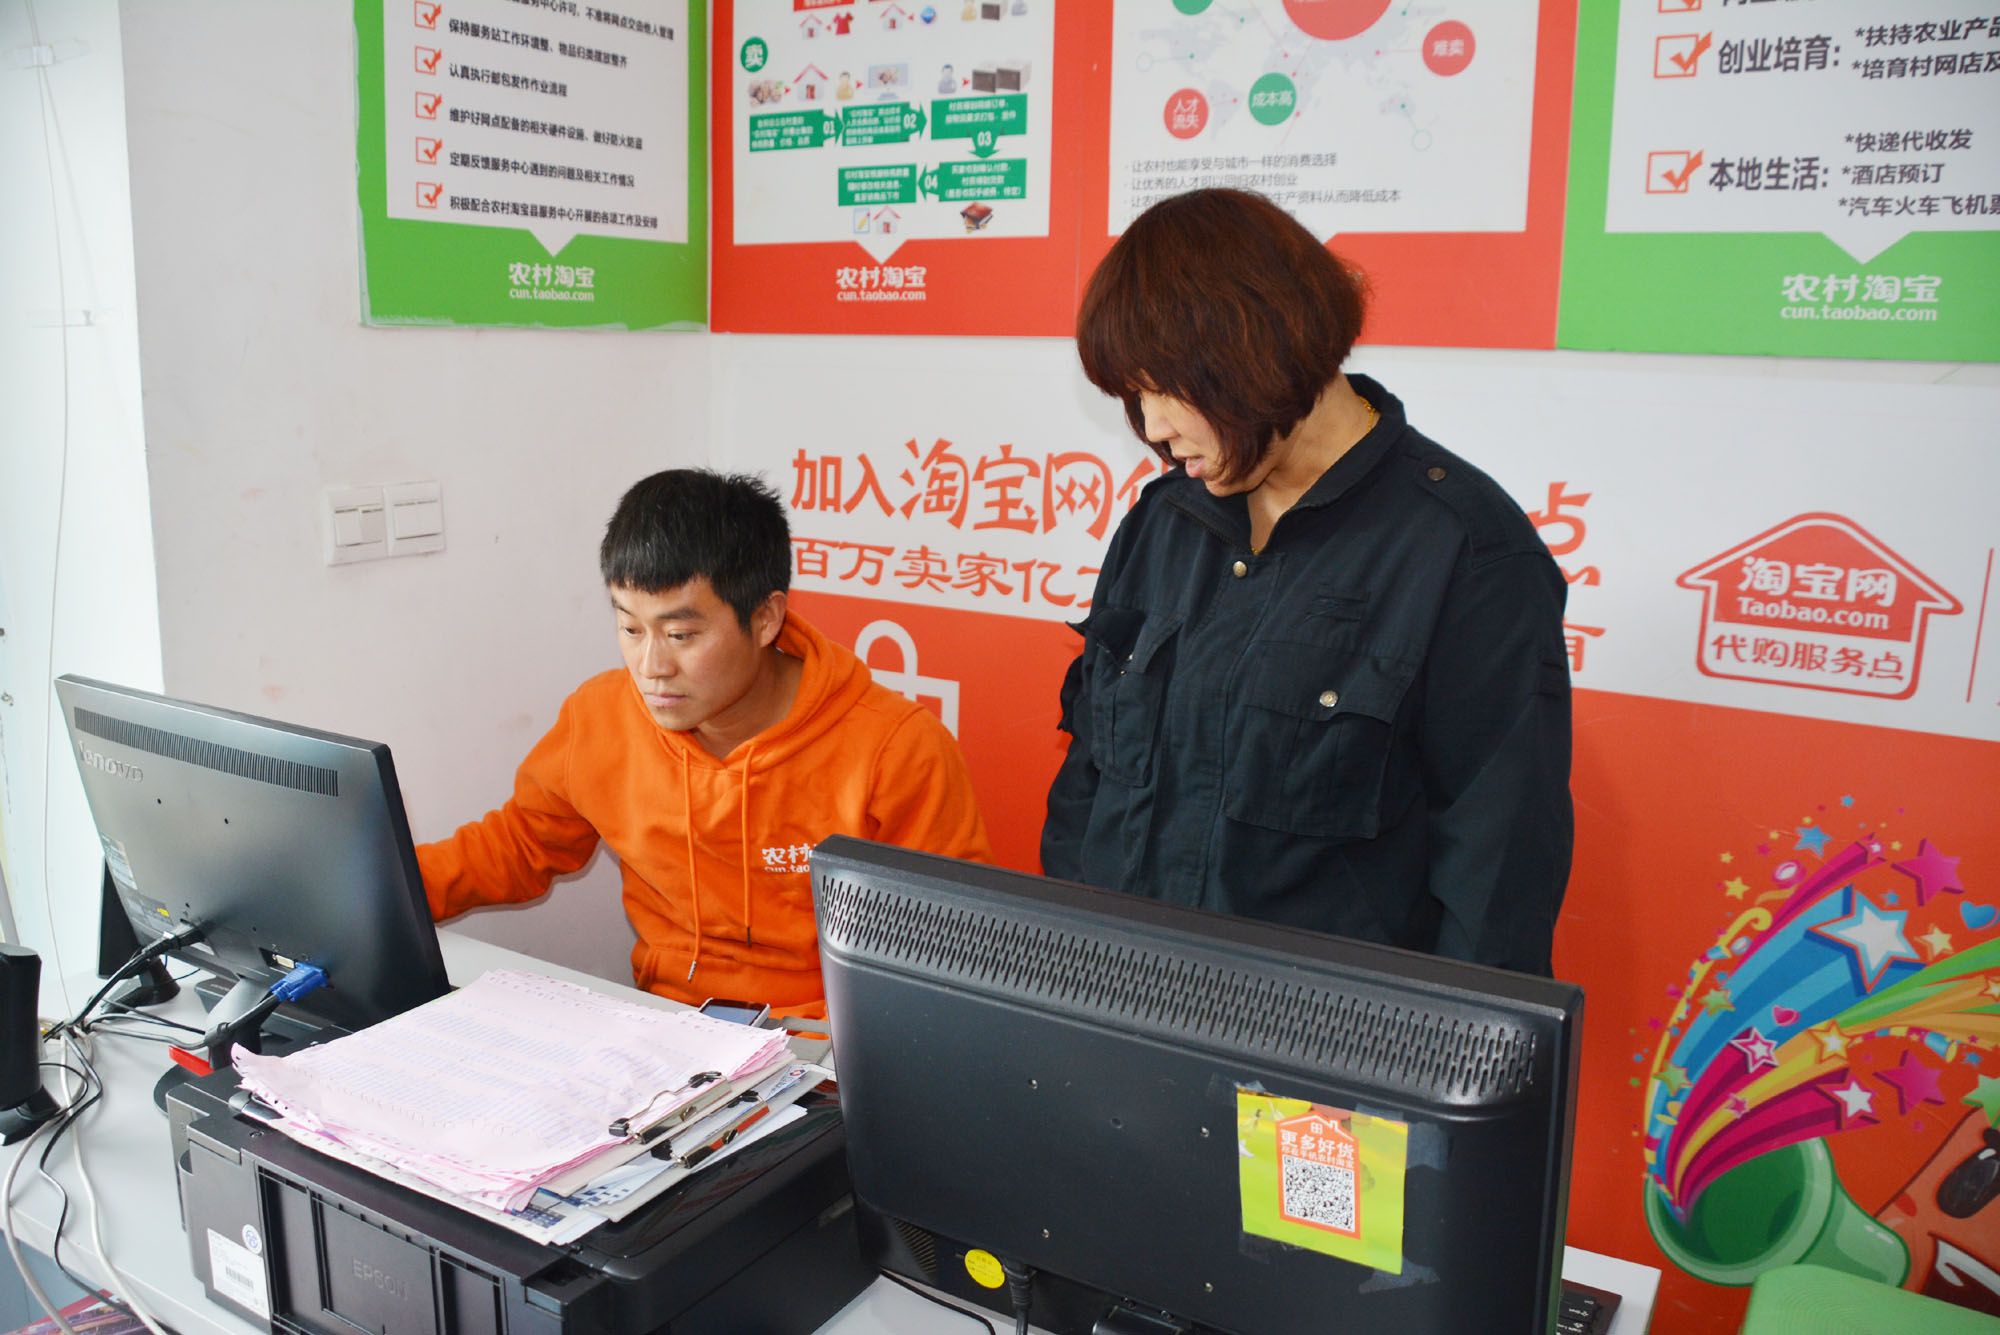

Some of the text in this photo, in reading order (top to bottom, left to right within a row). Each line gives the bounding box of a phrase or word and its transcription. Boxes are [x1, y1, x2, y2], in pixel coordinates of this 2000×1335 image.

[1172, 98, 1199, 113] 人才
[1251, 90, 1294, 109] 成本高
[823, 121, 836, 134] 01
[903, 114, 917, 129] 02
[1172, 113, 1200, 130] 流失
[977, 130, 992, 146] 03
[924, 174, 938, 189] 04
[508, 262, 595, 289] 农村淘宝
[836, 266, 927, 289] 农村淘宝
[509, 287, 595, 302] cun.taobao.com
[836, 288, 927, 301] cun.taobao.com
[1781, 273, 1942, 304] 农村淘宝
[1780, 304, 1938, 321] cun.taobao.com
[1737, 555, 1898, 607] 淘宝网
[1737, 596, 1889, 631] Taobao.com
[1710, 634, 1904, 681] 代购服务点
[762, 843, 817, 865] 农村
[1280, 1128, 1355, 1161] 更多好货
[352, 1259, 408, 1300] EPSON
